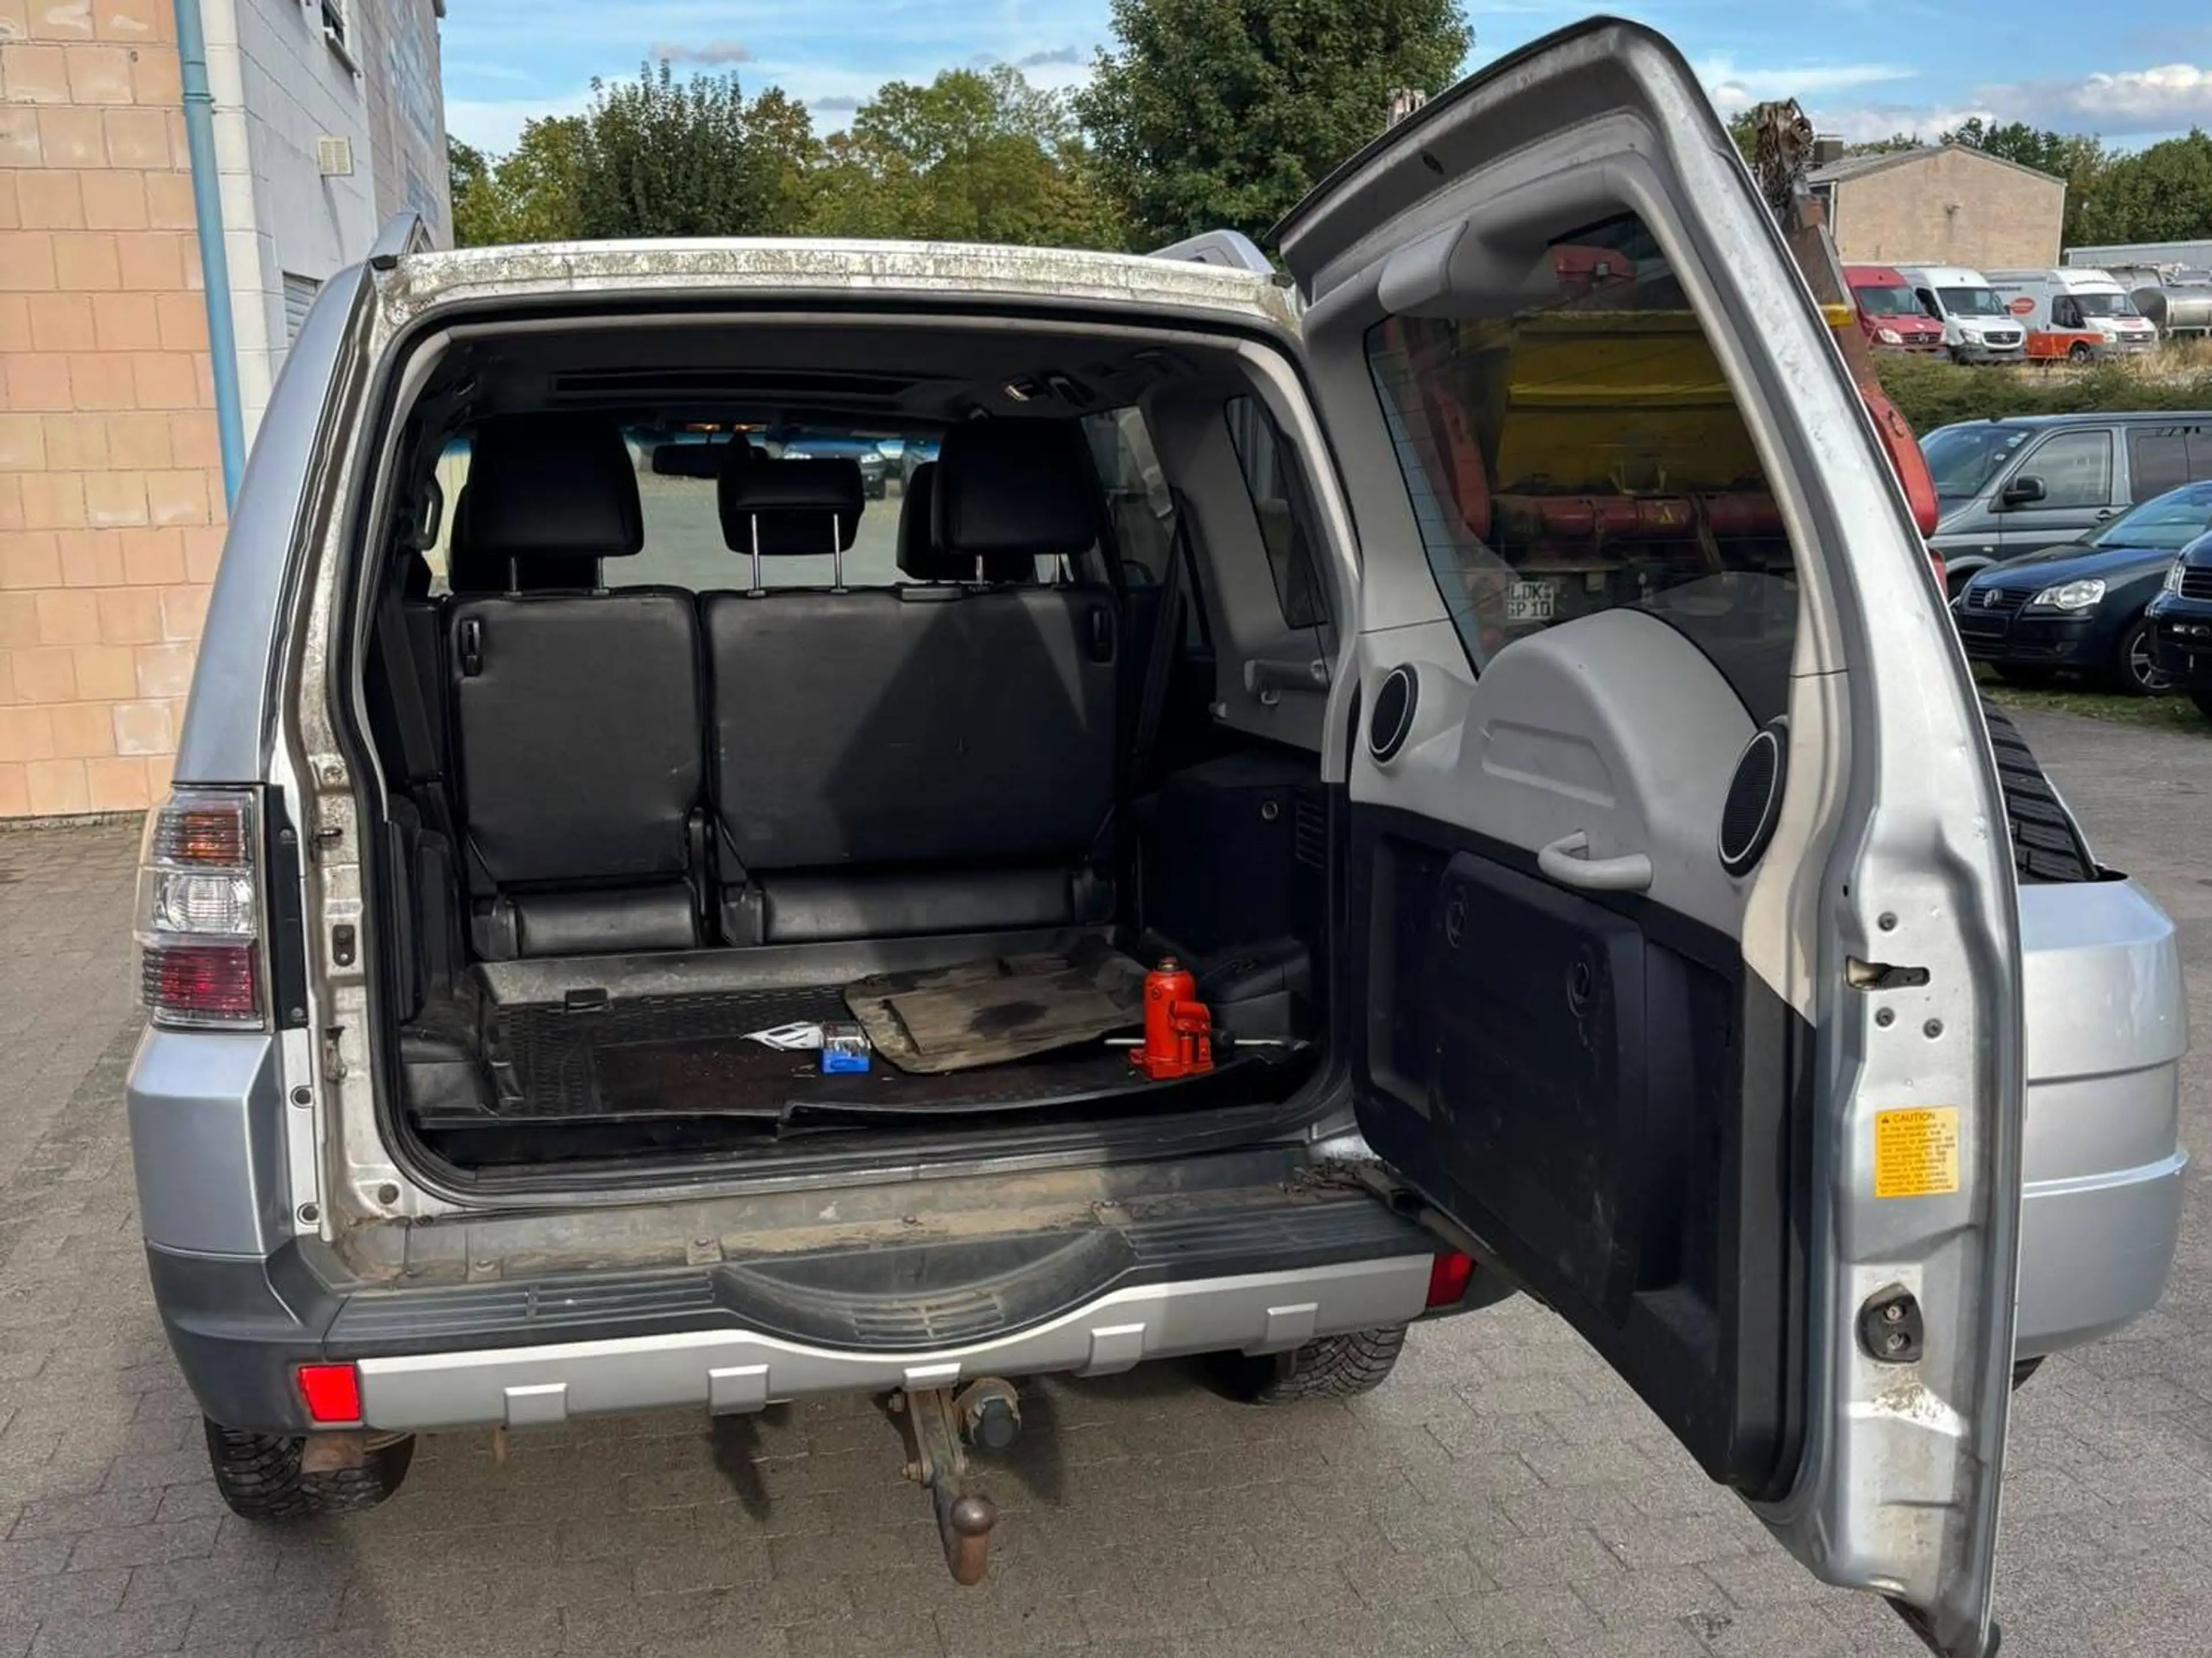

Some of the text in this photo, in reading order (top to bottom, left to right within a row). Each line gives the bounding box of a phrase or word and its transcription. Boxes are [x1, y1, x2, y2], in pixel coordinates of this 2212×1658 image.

[1511, 584, 1543, 600] LDK
[1531, 601, 1551, 617] 10
[1892, 1112, 1935, 1124] CAUTION
